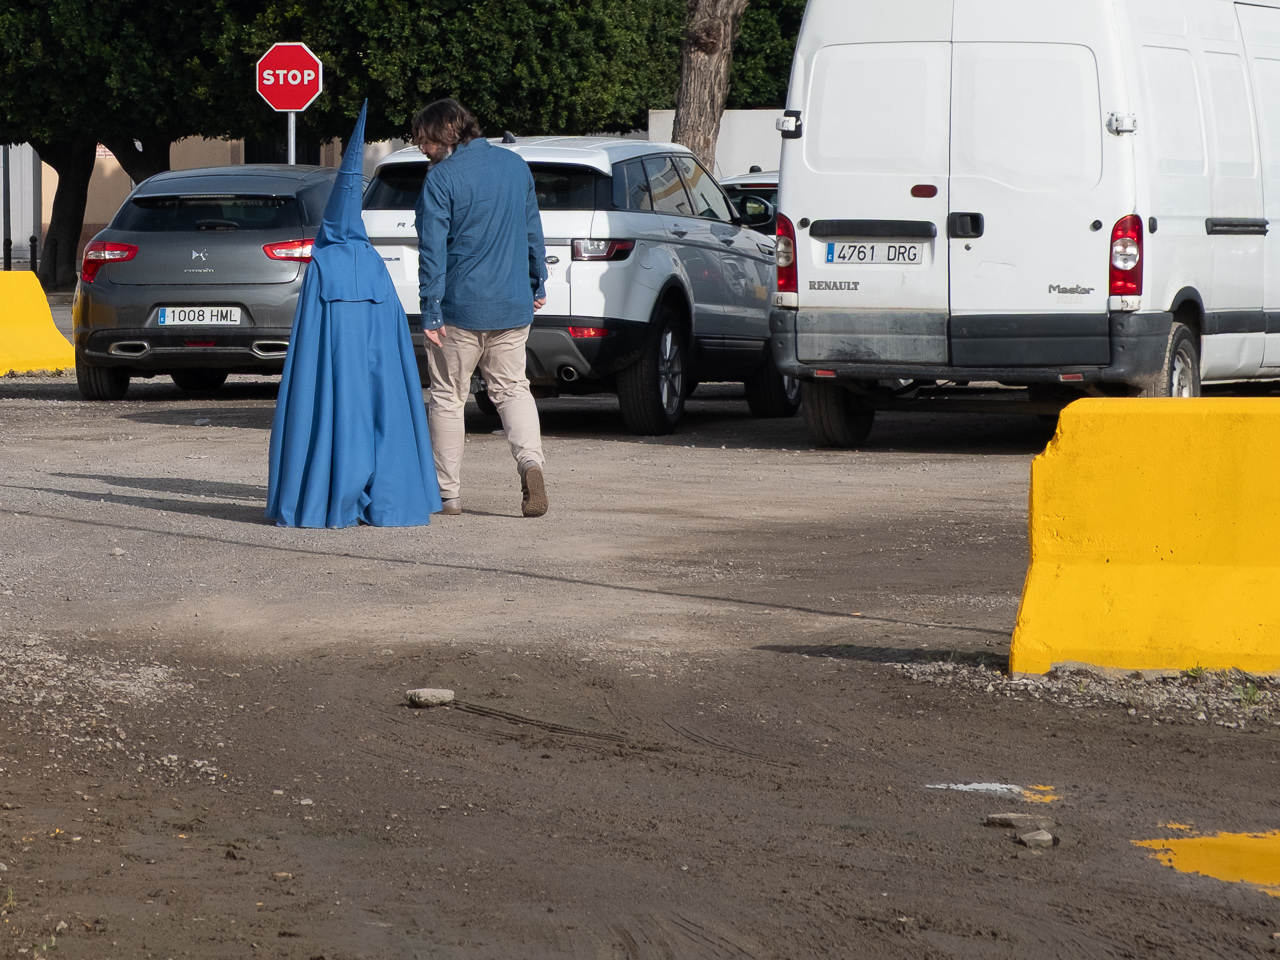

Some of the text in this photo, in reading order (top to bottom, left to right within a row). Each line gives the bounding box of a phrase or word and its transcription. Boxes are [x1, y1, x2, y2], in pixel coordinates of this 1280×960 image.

[262, 69, 316, 85] STOP
[837, 244, 917, 261] 4761 DRG
[808, 280, 860, 291] RENAULT
[1048, 284, 1095, 295] Master
[171, 309, 238, 322] 1008 HML
